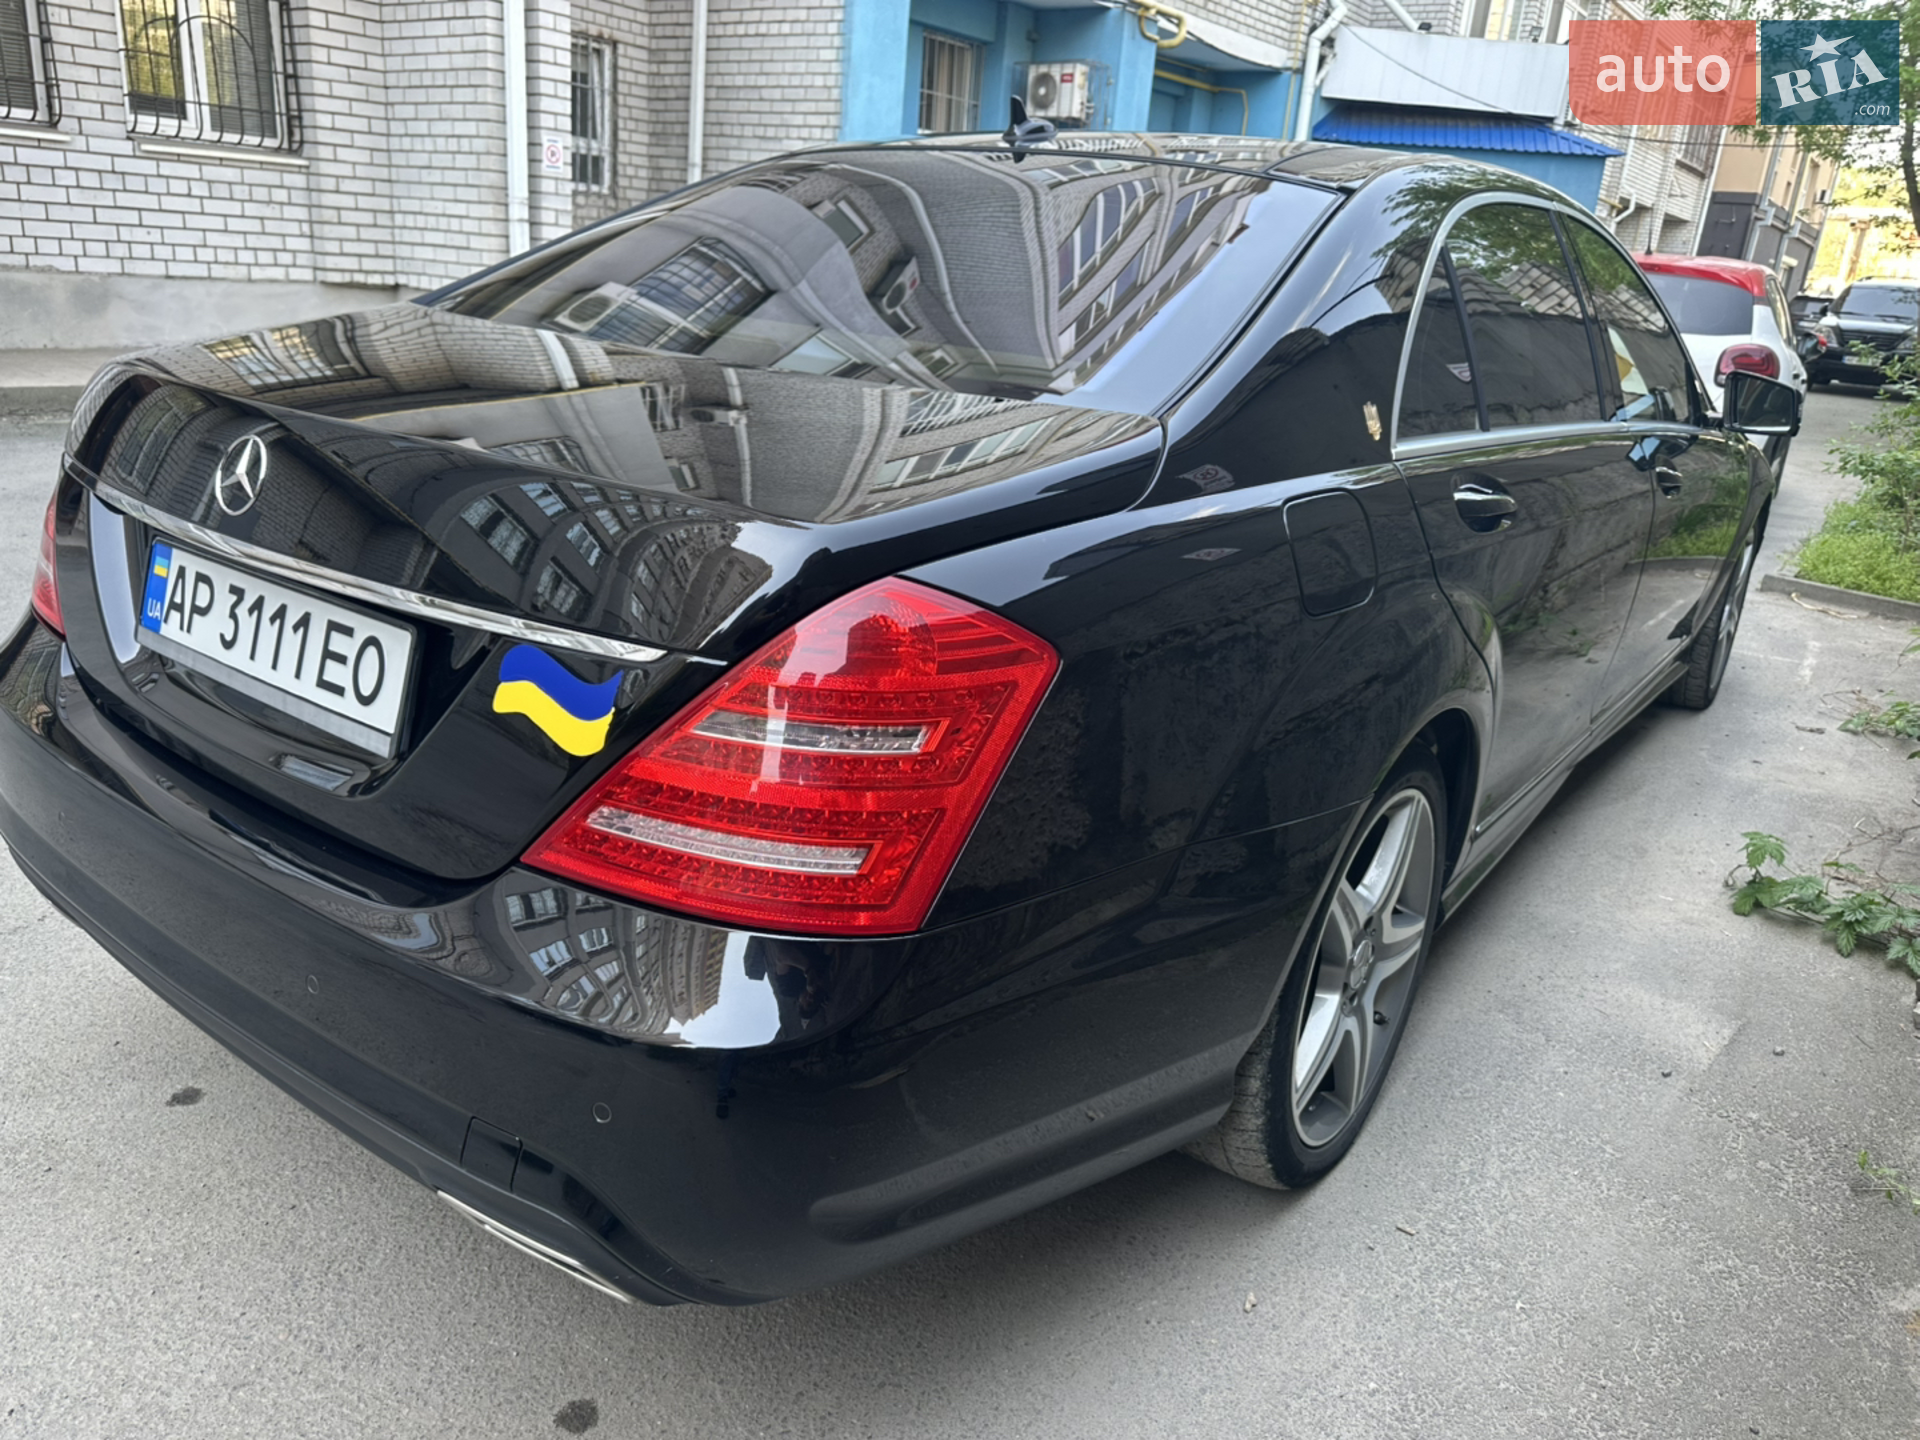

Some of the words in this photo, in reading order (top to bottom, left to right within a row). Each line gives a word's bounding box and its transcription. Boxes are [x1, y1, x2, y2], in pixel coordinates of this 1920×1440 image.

[147, 597, 161, 621] UA
[163, 564, 215, 634] AP
[219, 583, 312, 680] 3111
[315, 619, 385, 707] EO
